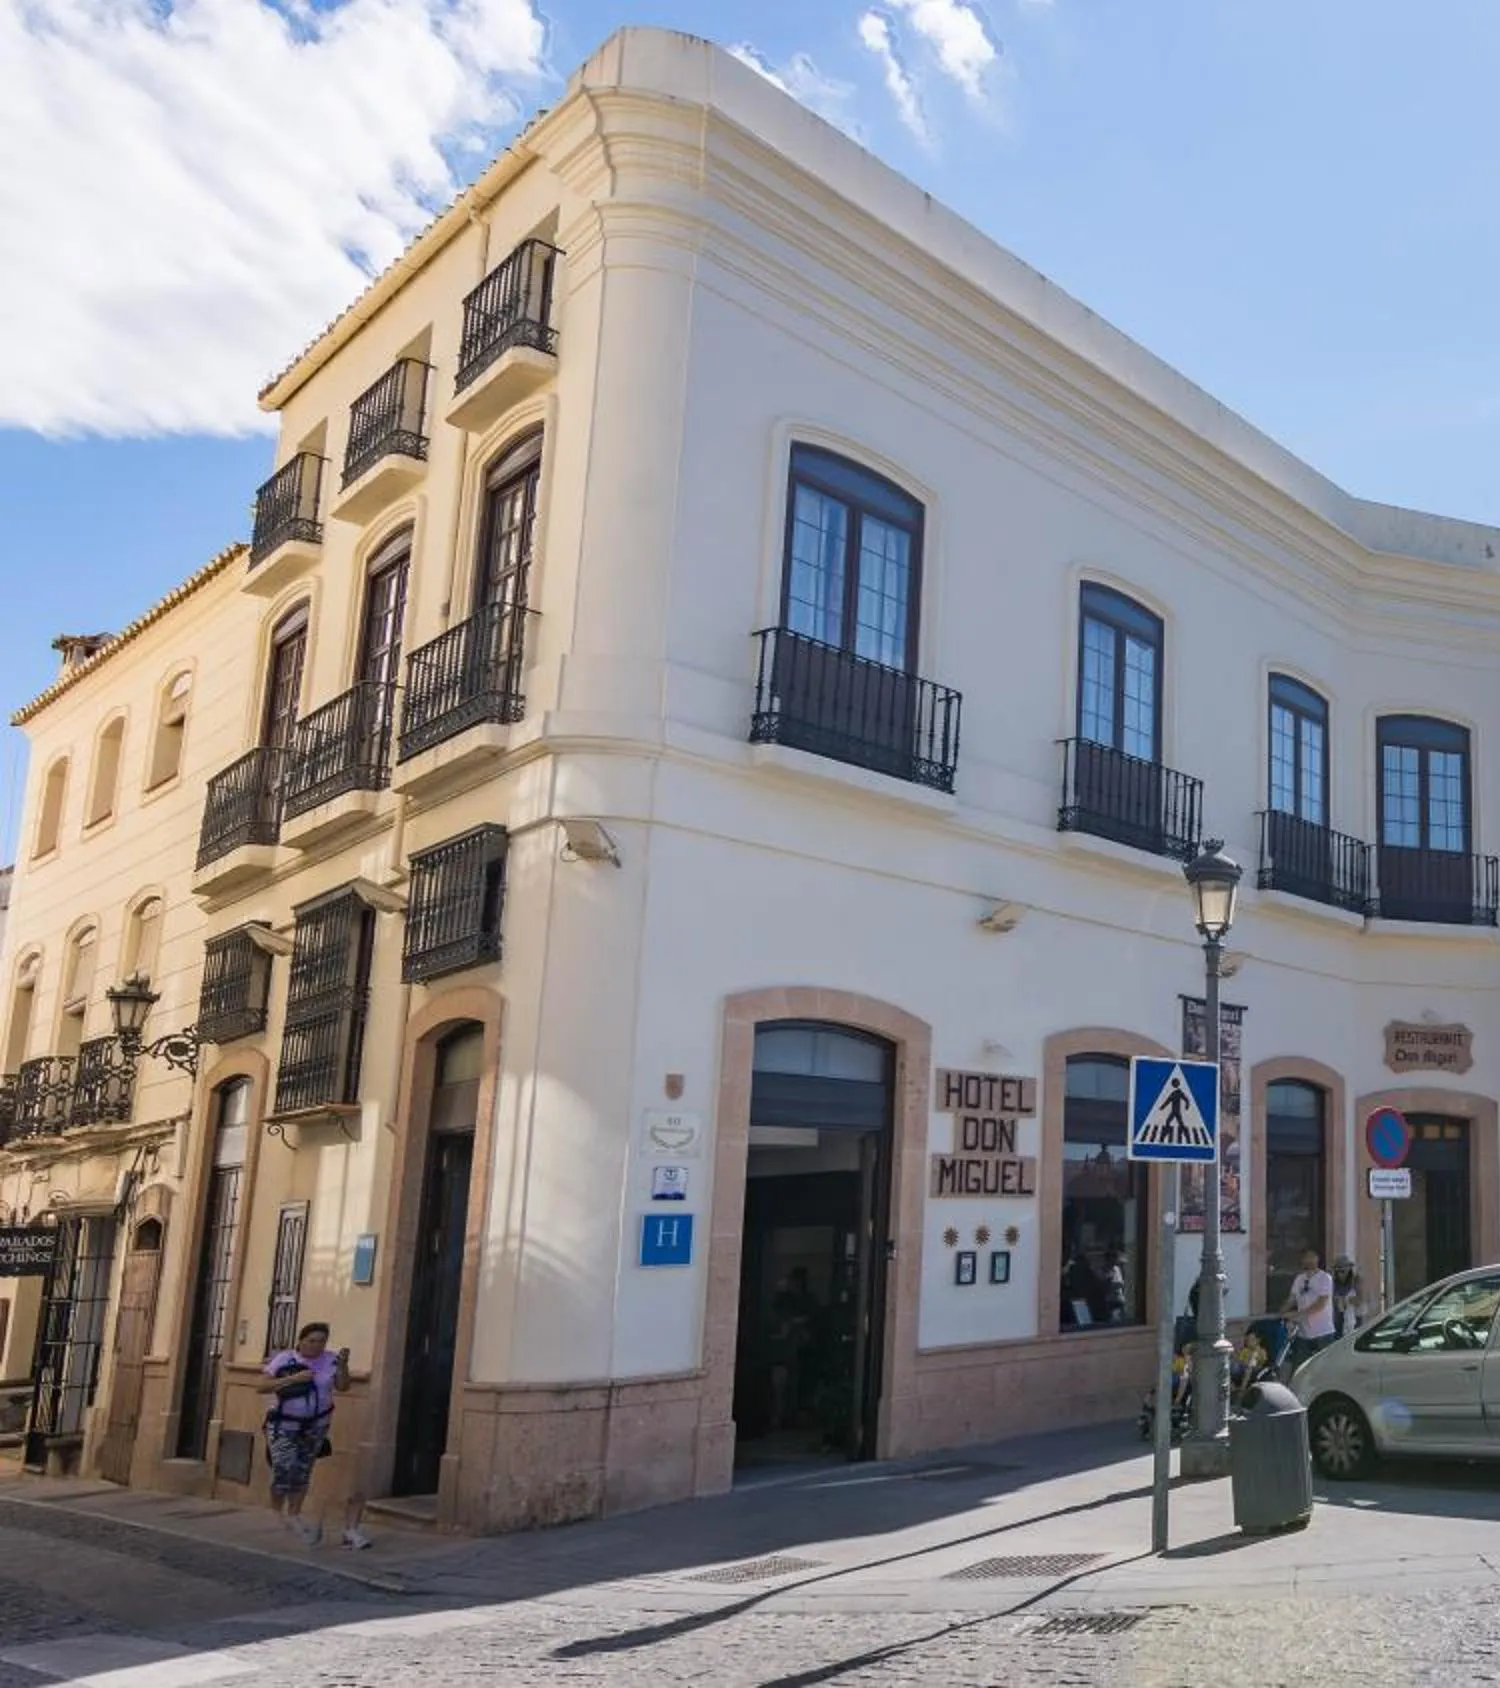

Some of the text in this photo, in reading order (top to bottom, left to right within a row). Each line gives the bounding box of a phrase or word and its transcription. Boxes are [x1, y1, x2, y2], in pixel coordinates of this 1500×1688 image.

[945, 1072, 1033, 1113] HOTEL
[962, 1116, 1016, 1152] DON
[938, 1158, 1034, 1195] MIGUEL
[656, 1219, 679, 1247] H
